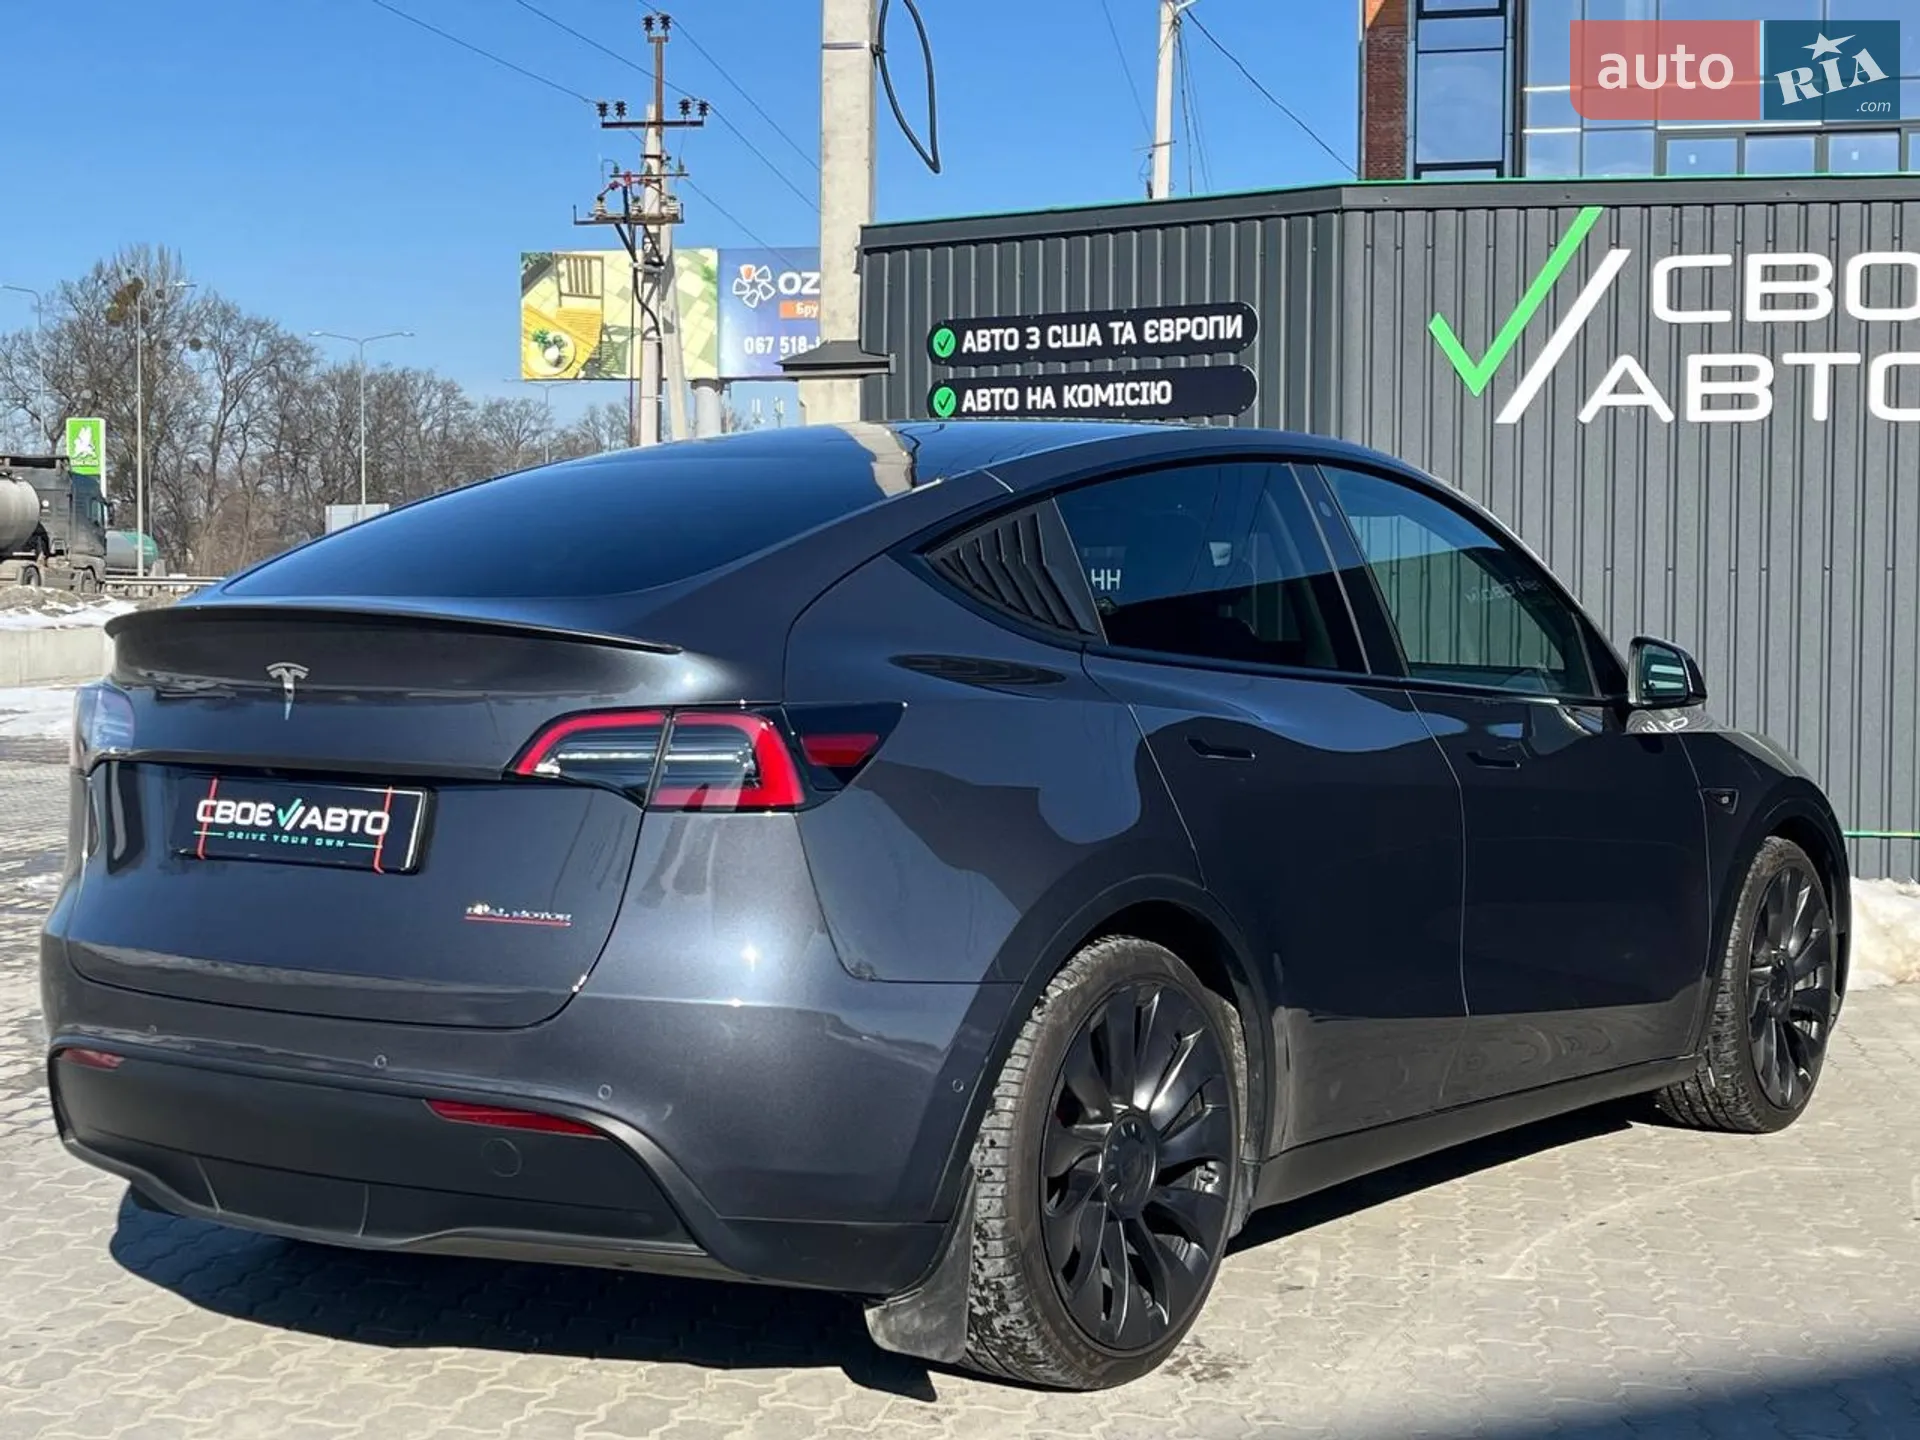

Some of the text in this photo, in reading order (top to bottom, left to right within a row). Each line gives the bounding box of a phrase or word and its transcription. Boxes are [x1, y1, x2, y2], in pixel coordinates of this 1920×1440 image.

[1652, 252, 1920, 323] СВО
[744, 337, 774, 355] 067
[962, 327, 1020, 354] АВТО
[1047, 323, 1102, 348] США
[1109, 320, 1137, 346] ТА
[1143, 314, 1243, 343] ЄВРОПИ
[962, 380, 1173, 413] АВТО НА КОМІСІЮ
[1577, 352, 1920, 424] АВТО
[300, 806, 390, 836] АВТО
[227, 831, 345, 848] DRIVE YOUR OWN
